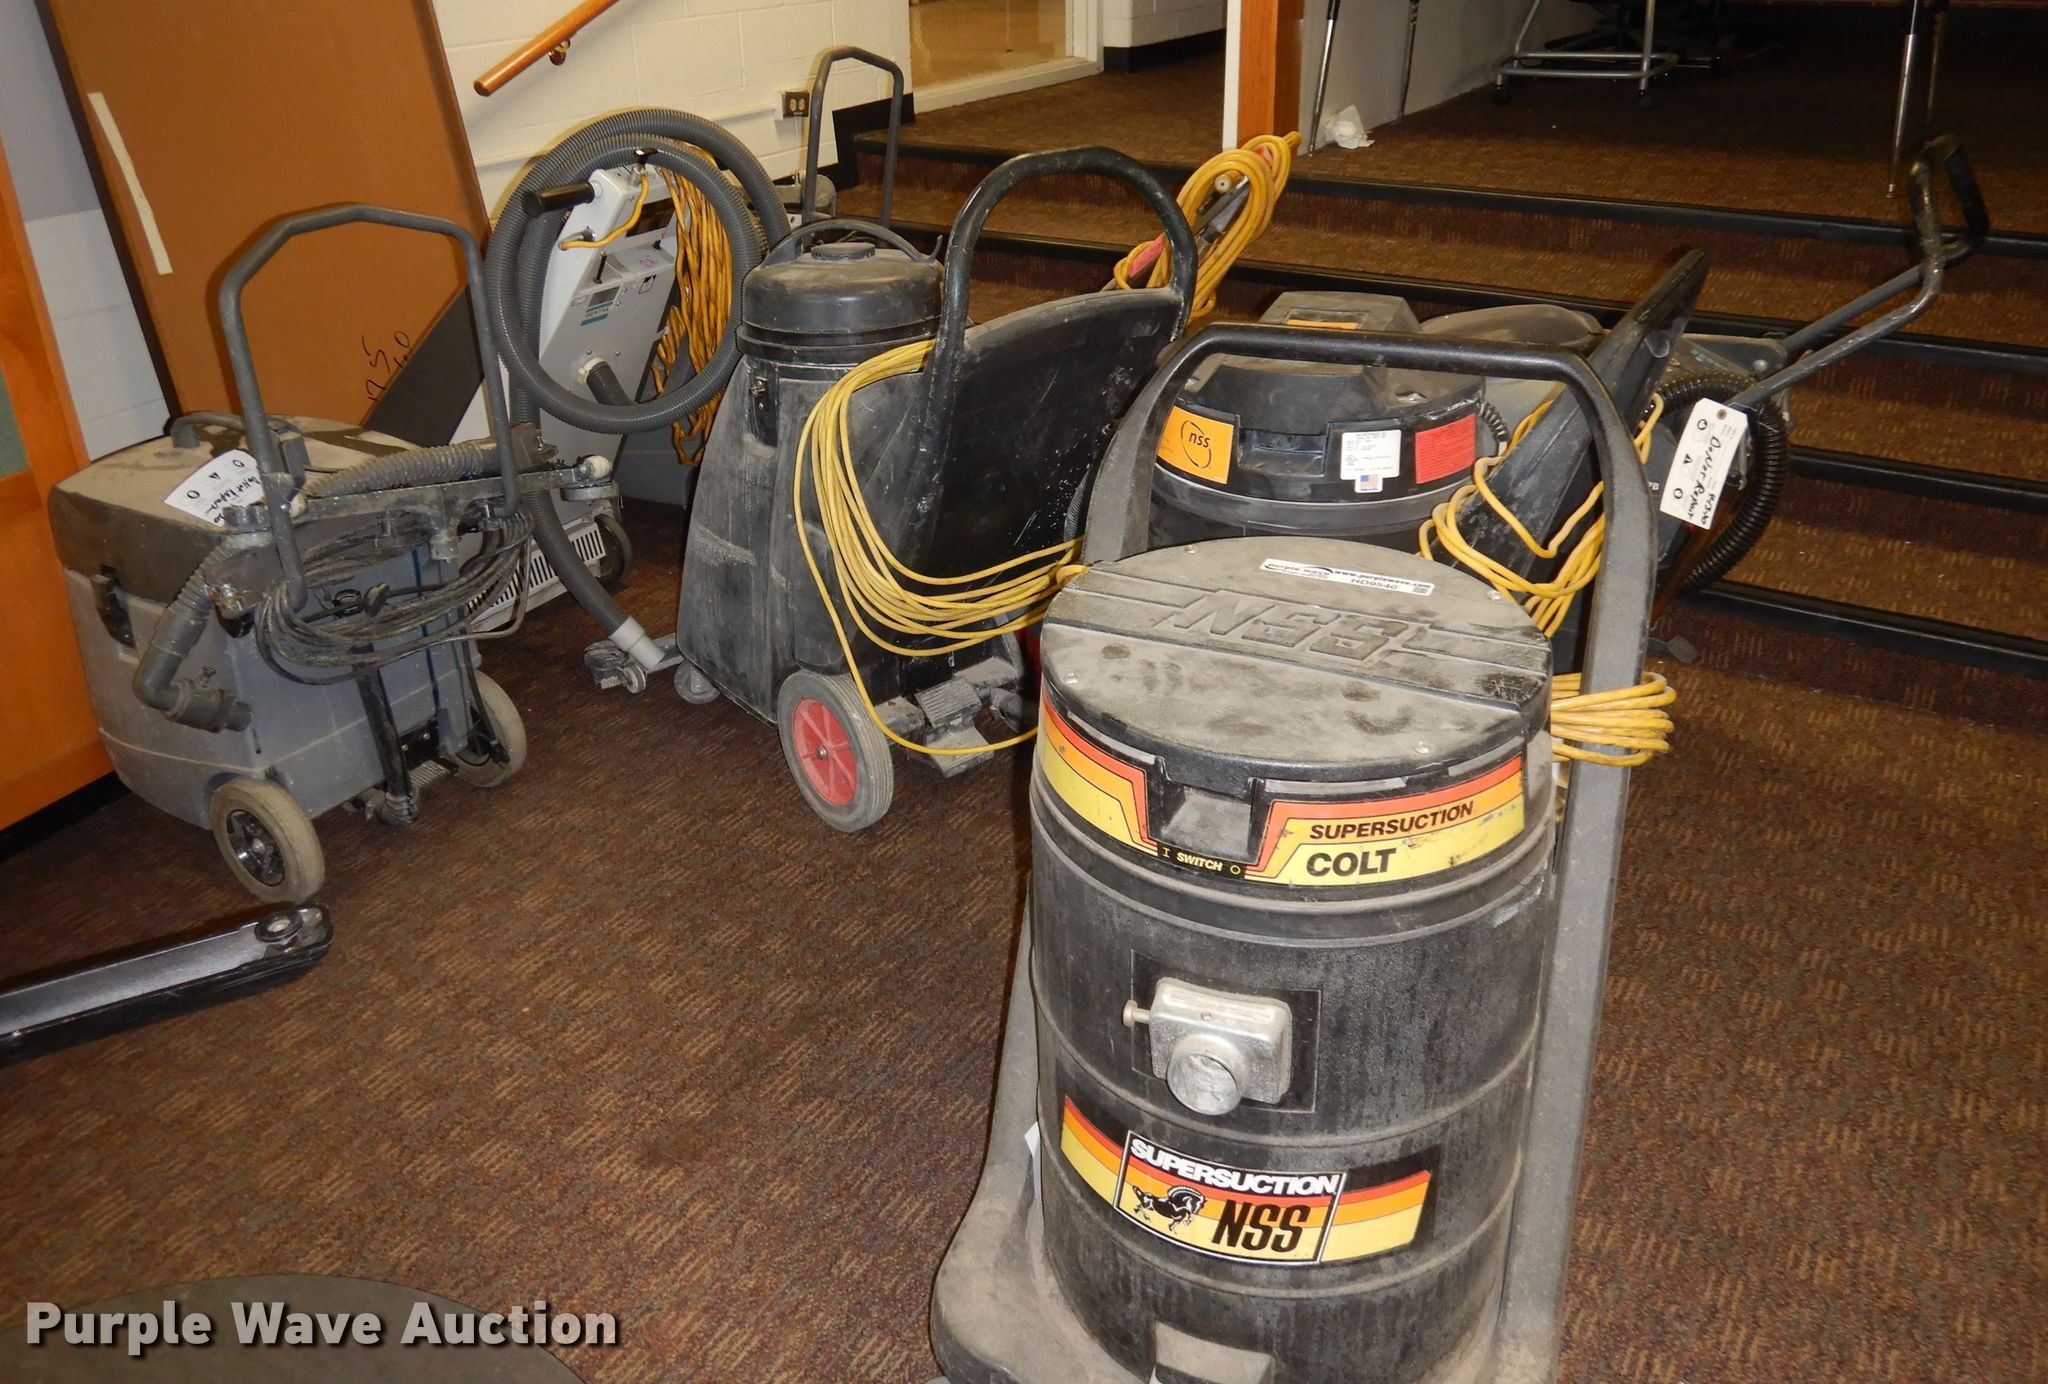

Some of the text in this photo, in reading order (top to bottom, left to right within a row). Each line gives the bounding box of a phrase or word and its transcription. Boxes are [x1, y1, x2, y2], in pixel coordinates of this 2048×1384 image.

[1189, 432, 1210, 448] nss
[1173, 588, 1410, 661] NSS
[1309, 801, 1474, 840] SUPERSUCTION
[1176, 852, 1223, 872] SWITCH
[1306, 847, 1397, 877] COLT
[1130, 1138, 1340, 1196] SUPERSUCTION
[1212, 1199, 1311, 1252] NSS
